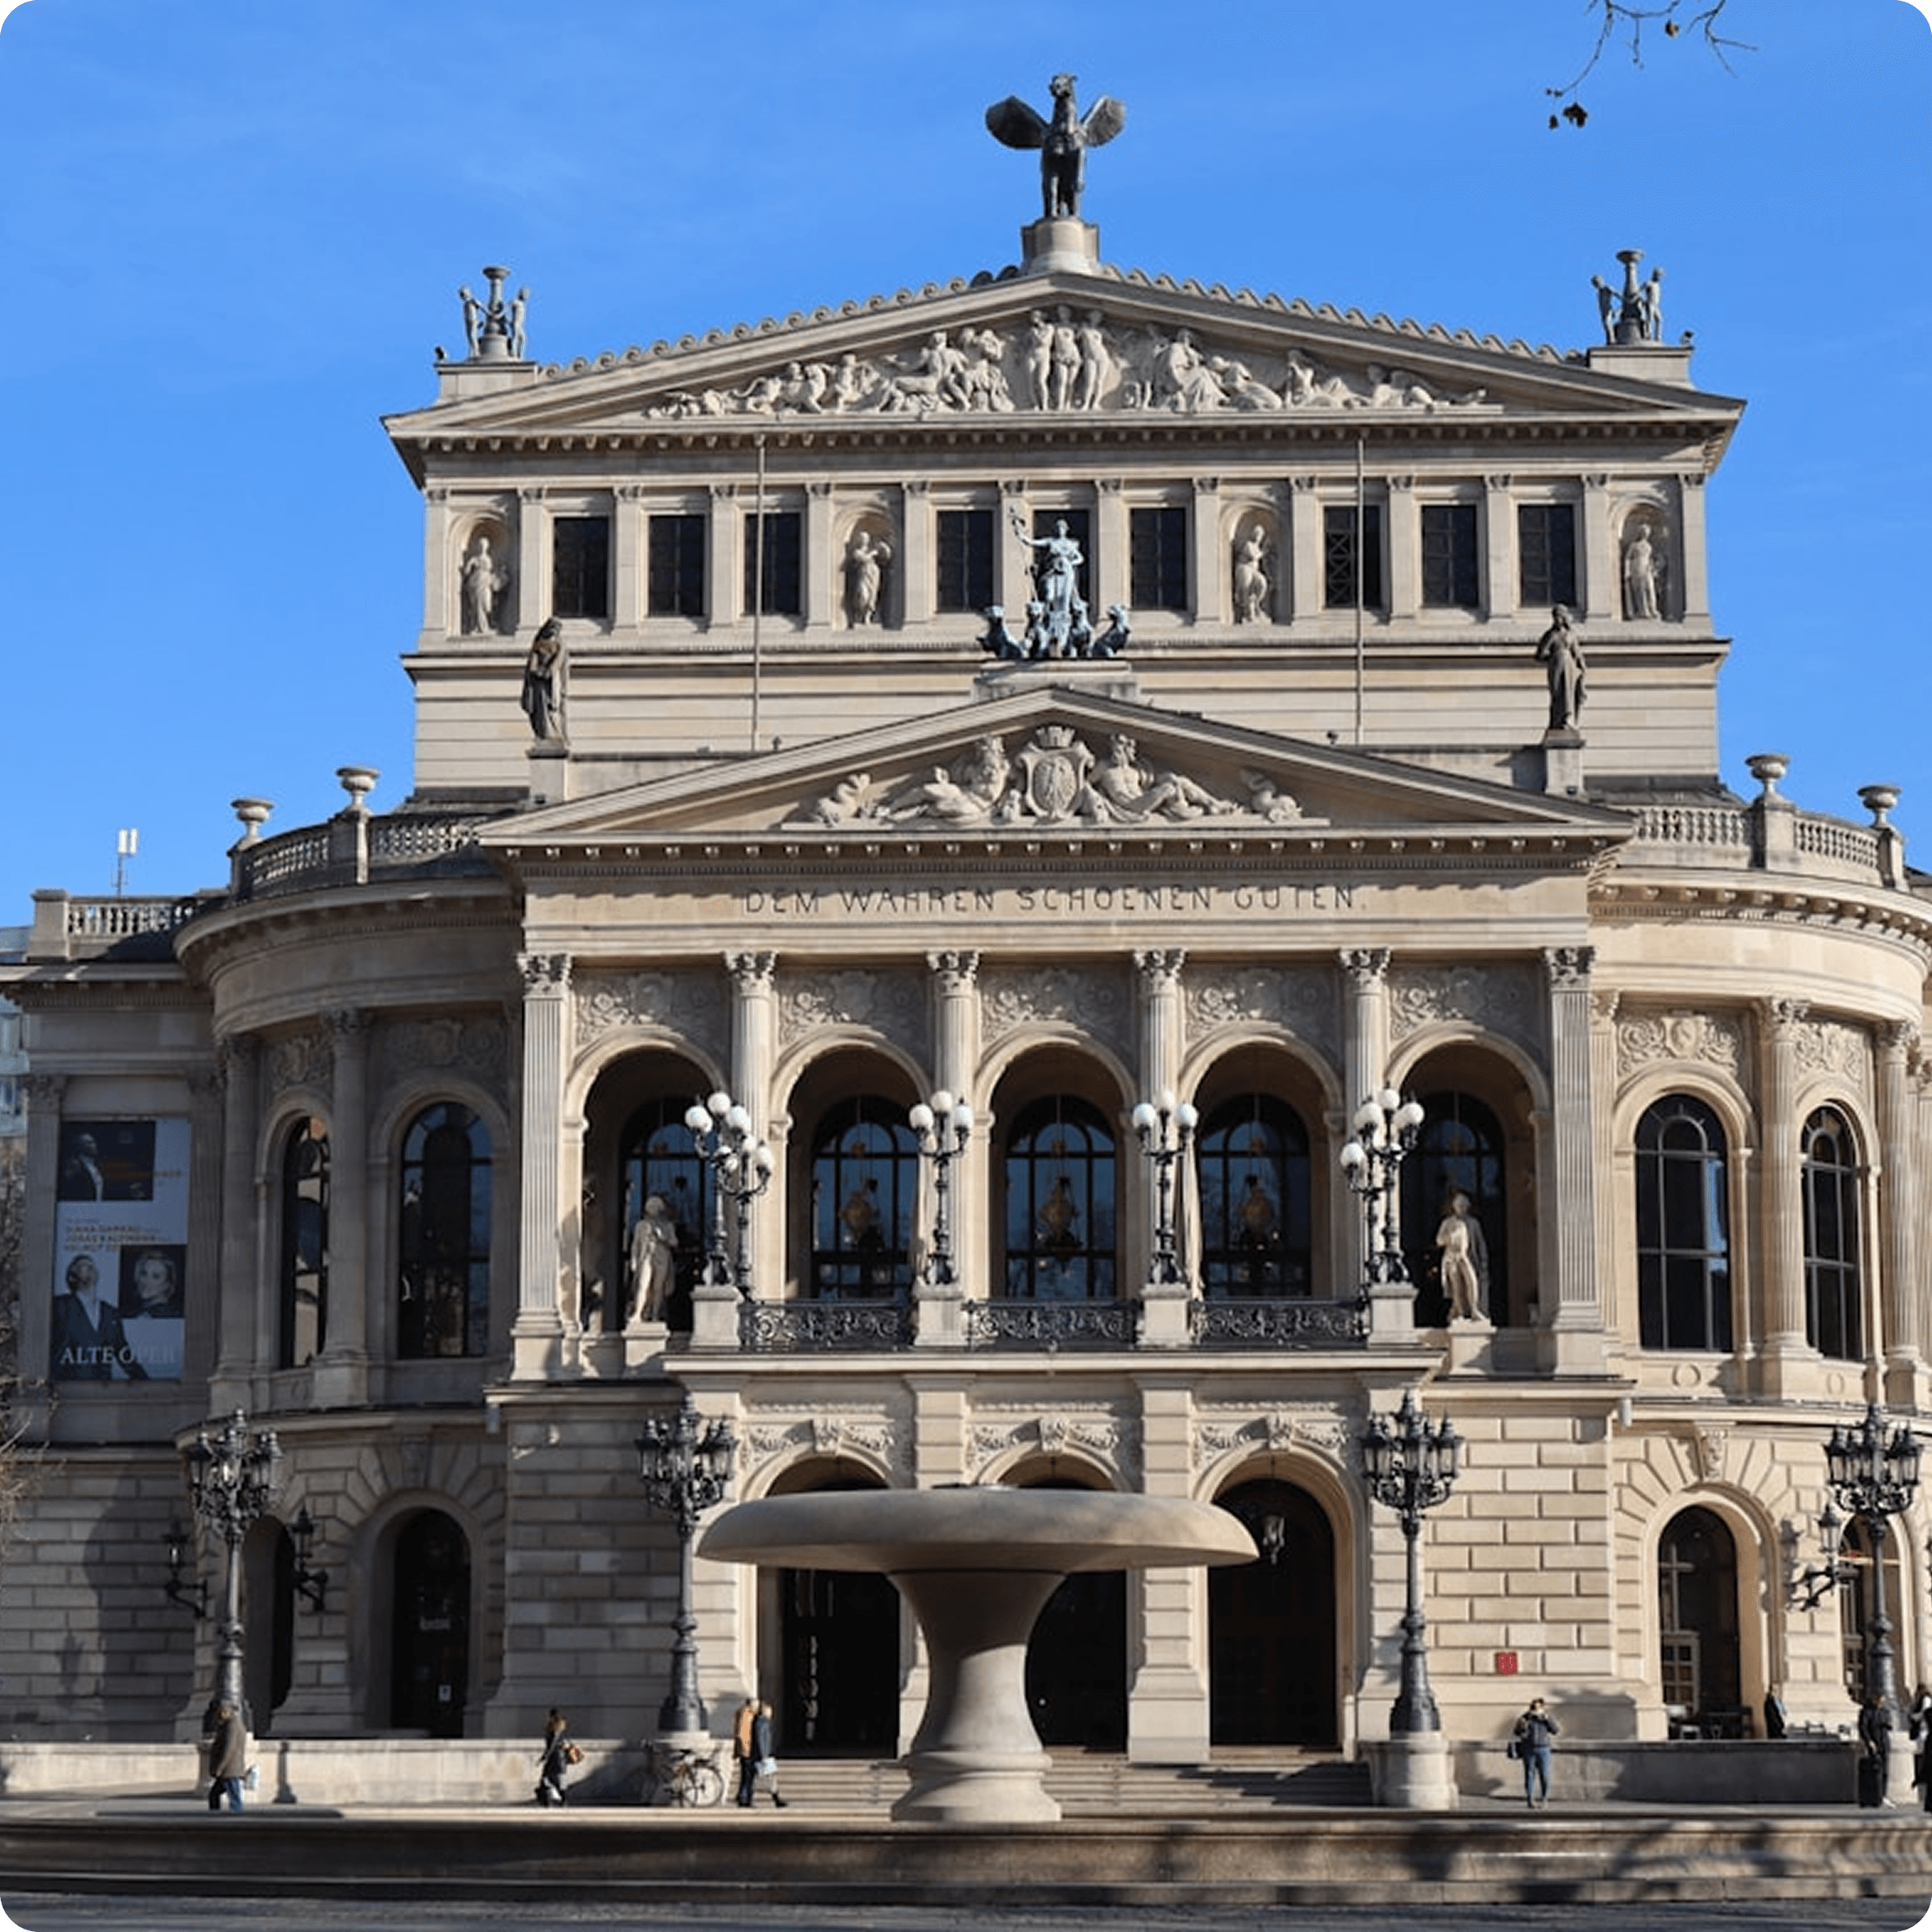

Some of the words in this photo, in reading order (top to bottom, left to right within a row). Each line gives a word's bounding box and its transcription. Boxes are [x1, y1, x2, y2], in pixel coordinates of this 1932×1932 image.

[745, 888, 819, 913] DEM
[838, 886, 995, 913] WAHREN
[1015, 885, 1212, 912] SCHOENEN
[59, 1346, 115, 1365] ALTE
